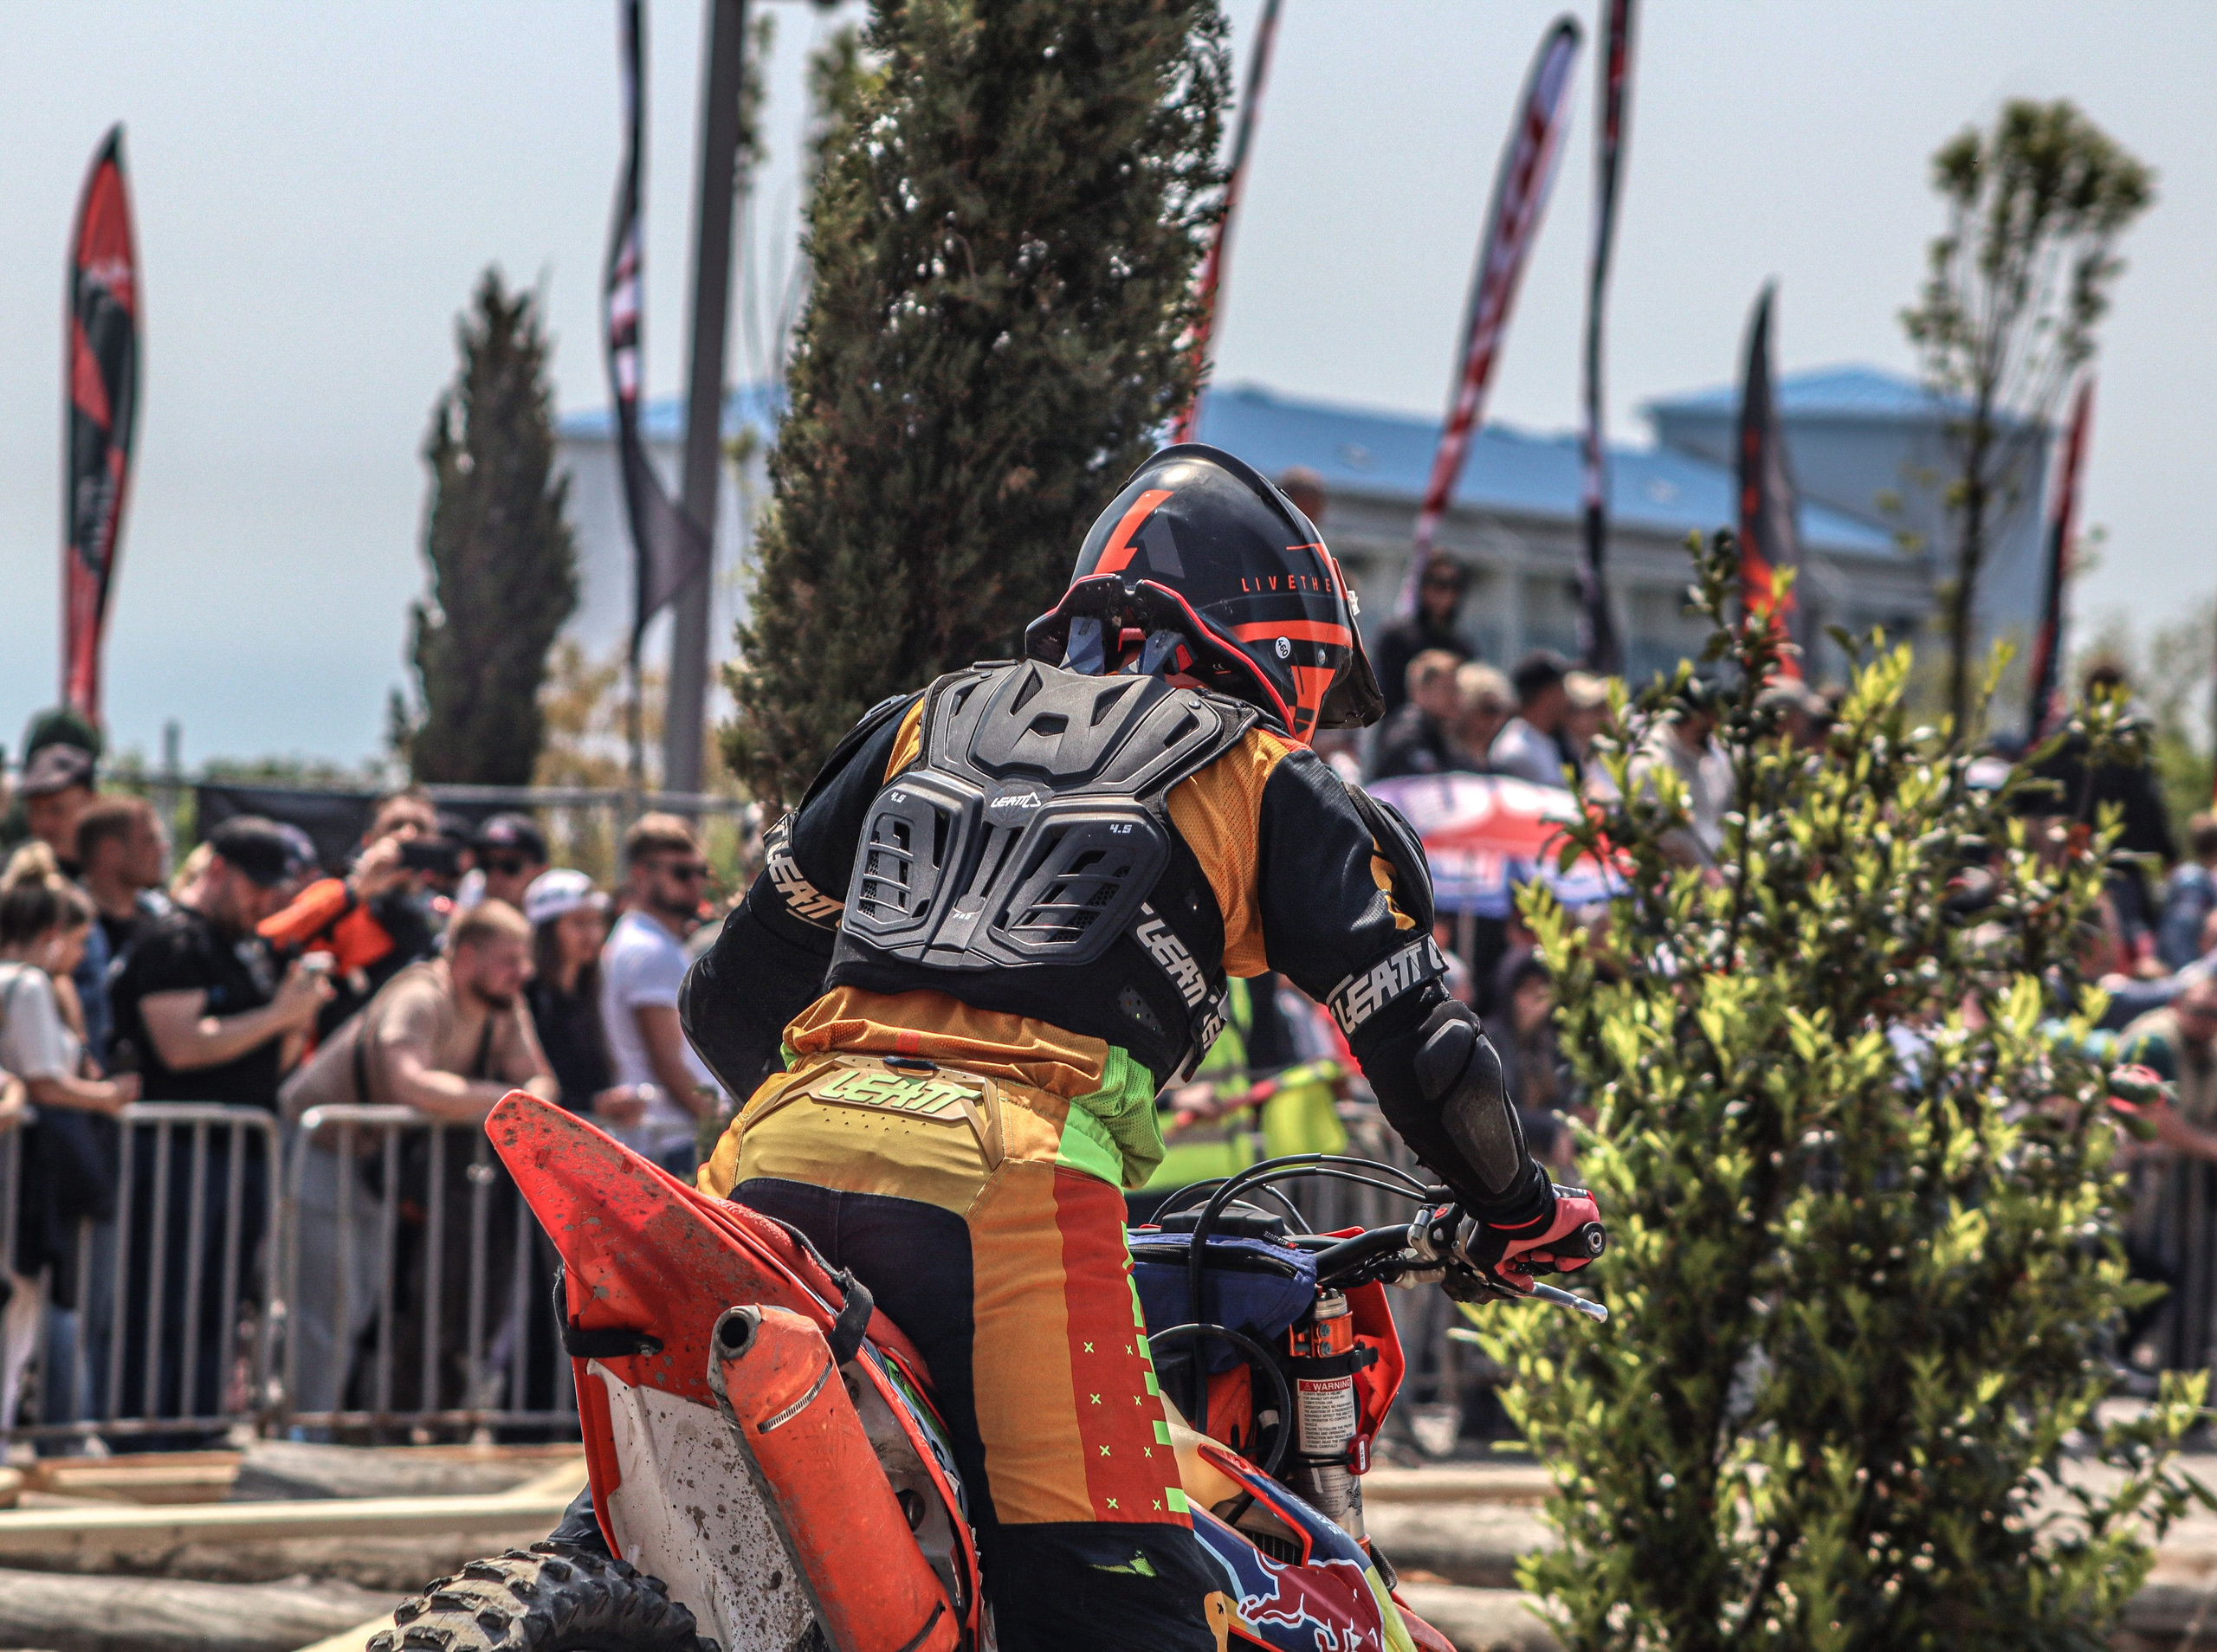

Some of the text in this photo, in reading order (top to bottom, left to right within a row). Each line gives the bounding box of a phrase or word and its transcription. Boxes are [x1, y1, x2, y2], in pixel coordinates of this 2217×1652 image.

[1277, 640, 1289, 656] 460
[1109, 823, 1132, 834] 4.5
[1335, 942, 1423, 1034] LEATT
[818, 1071, 982, 1113] LEATT
[1313, 1378, 1351, 1391] WARNING
